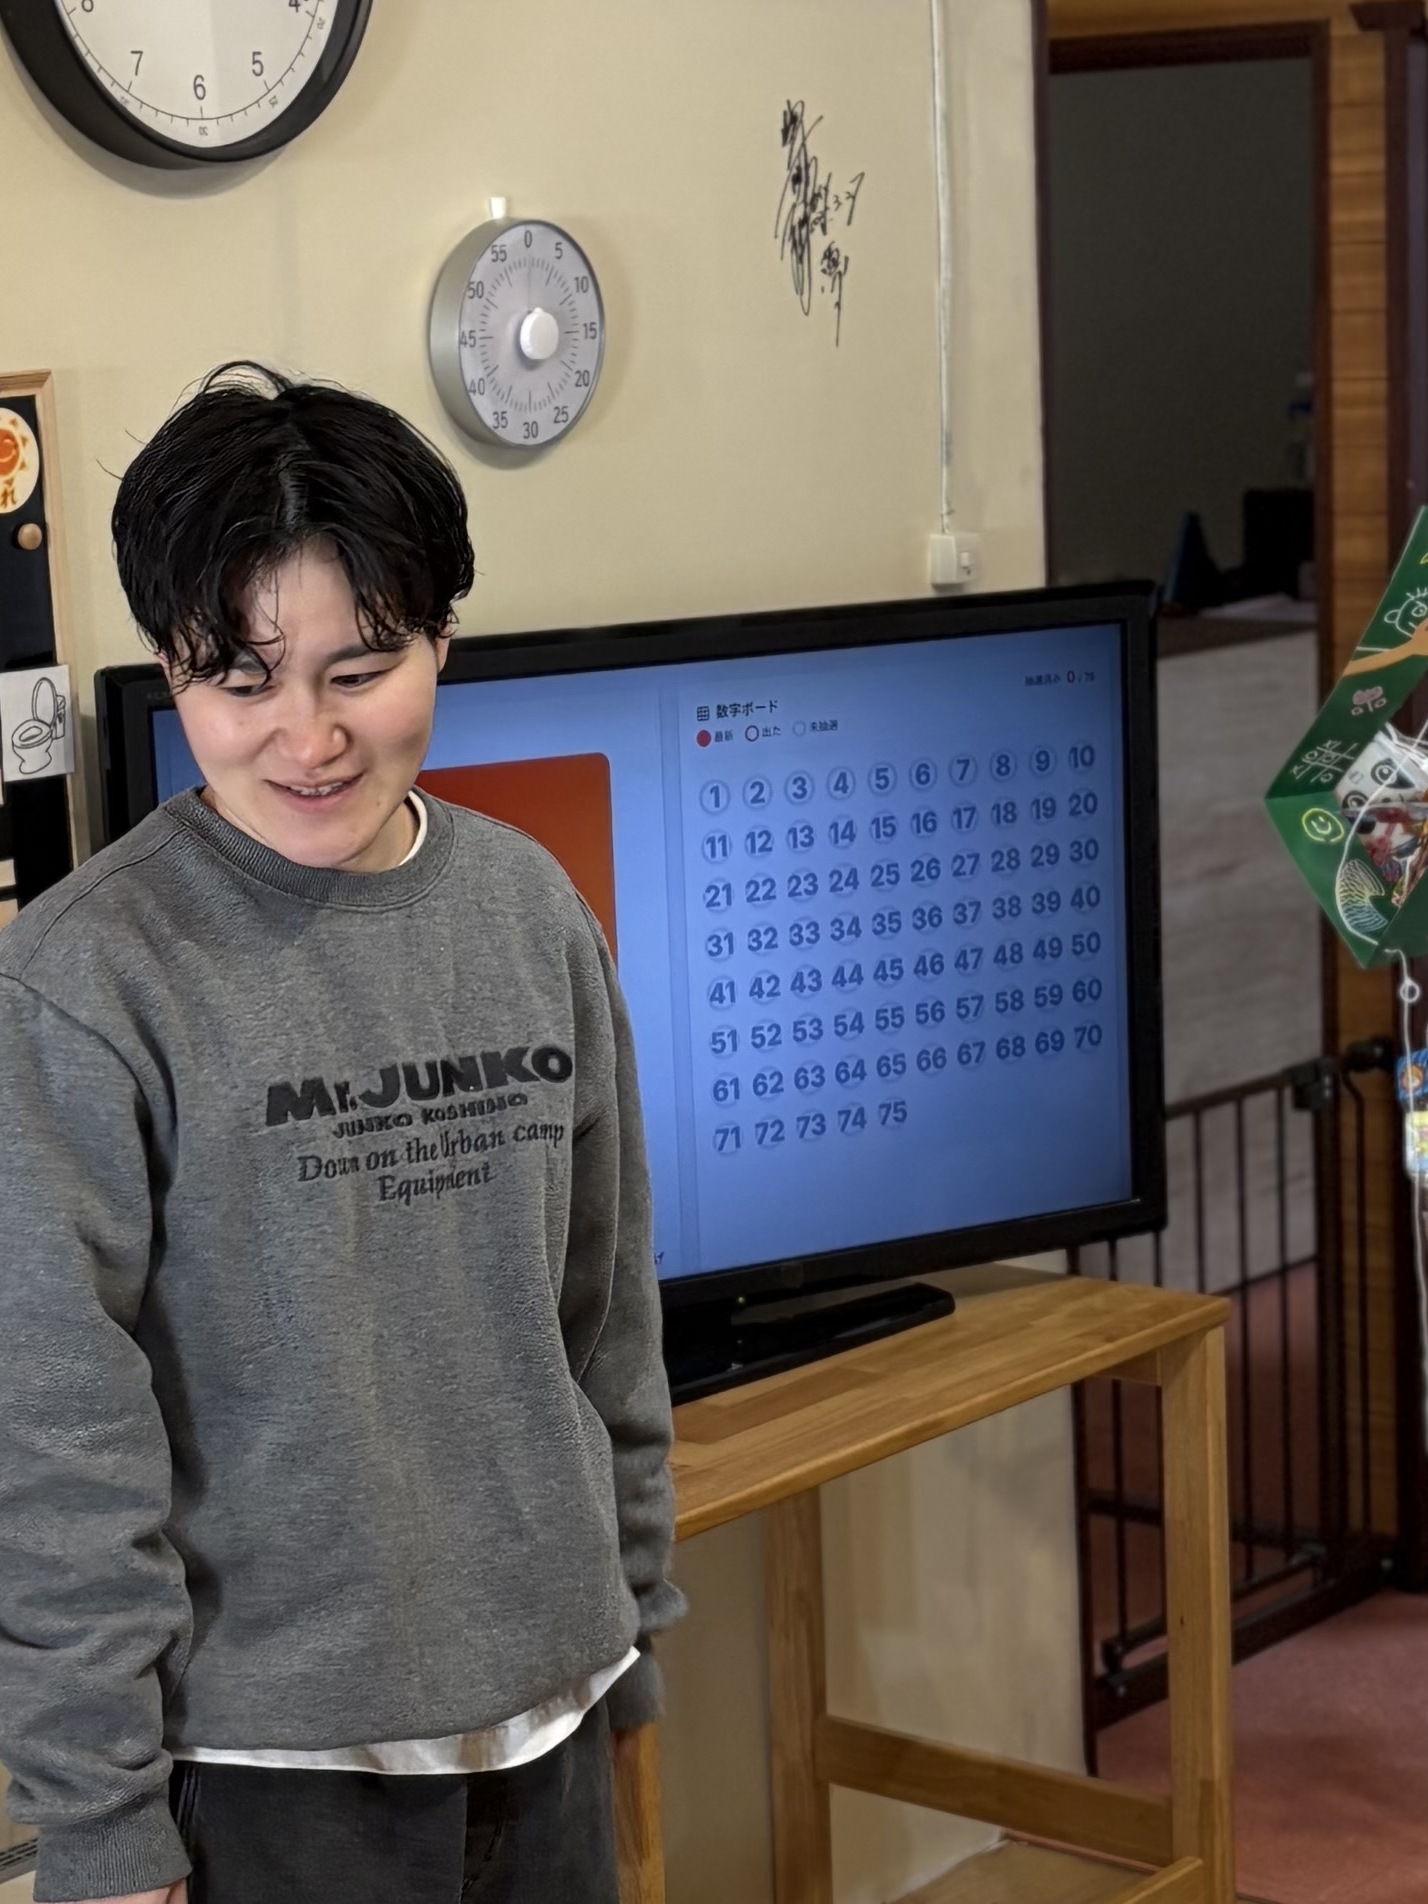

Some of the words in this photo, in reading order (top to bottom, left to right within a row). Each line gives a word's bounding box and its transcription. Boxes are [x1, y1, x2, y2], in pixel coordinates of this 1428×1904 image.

[130, 50, 144, 76] 7
[251, 51, 264, 77] 5
[193, 74, 207, 101] 6
[524, 230, 533, 248] 0
[491, 244, 508, 263] 55
[555, 242, 563, 260] 5
[467, 280, 485, 299] 50
[574, 275, 590, 294] 10
[460, 330, 477, 347] 45
[583, 322, 598, 340] 15
[468, 377, 486, 396] 40
[574, 369, 591, 387] 20
[492, 411, 509, 430] 35
[553, 406, 570, 424] 25
[523, 421, 539, 439] 30
[716, 700, 779, 720] 数字ボード
[709, 785, 721, 808] 1
[749, 780, 766, 804] 2
[792, 775, 808, 800] 3
[833, 771, 849, 794] 4
[875, 767, 890, 791] 5
[915, 762, 931, 786] 6
[956, 758, 971, 782] 7
[995, 753, 1011, 777] 8
[1035, 749, 1051, 773] 9
[1069, 744, 1096, 769] 10
[706, 834, 728, 859] 11
[745, 829, 773, 855] 12
[787, 824, 815, 849] 13
[829, 819, 857, 845] 14
[870, 814, 897, 840] 15
[911, 810, 938, 835] 16
[952, 805, 977, 830] 17
[991, 800, 1018, 826] 18
[1031, 796, 1057, 821] 19
[1068, 790, 1099, 817] 20
[705, 882, 732, 909] 21
[745, 877, 777, 903] 22
[787, 872, 819, 898] 23
[828, 867, 860, 893] 24
[870, 862, 901, 888] 25
[910, 856, 941, 883] 26
[952, 852, 981, 878] 27
[991, 847, 1021, 873] 28
[1030, 842, 1061, 868] 29
[1069, 837, 1100, 863] 30
[707, 931, 734, 958] 31
[747, 926, 779, 953] 32
[789, 920, 821, 947] 33
[830, 915, 863, 942] 34
[872, 910, 902, 936] 35
[912, 904, 943, 931] 36
[953, 900, 982, 926] 37
[992, 894, 1023, 920] 38
[1031, 889, 1062, 915] 39
[1070, 884, 1101, 910] 40
[709, 980, 736, 1005] 41
[748, 973, 781, 1000] 42
[790, 968, 823, 994] 43
[831, 963, 865, 988] 44
[872, 957, 905, 982] 45
[913, 952, 945, 977] 46
[954, 946, 984, 971] 47
[993, 941, 1024, 966] 48
[1032, 936, 1063, 961] 49
[1071, 930, 1102, 957] 50
[711, 1028, 738, 1055] 51
[751, 1022, 783, 1050] 52
[792, 1017, 824, 1043] 53
[833, 1011, 865, 1038] 54
[875, 1005, 905, 1032] 55
[915, 999, 946, 1026] 56
[956, 994, 985, 1021] 57
[995, 988, 1025, 1014] 58
[1034, 983, 1064, 1009] 59
[1072, 977, 1103, 1004] 60
[712, 1077, 741, 1103] 61
[752, 1070, 785, 1097] 62
[794, 1064, 826, 1091] 63
[834, 1058, 868, 1085] 64
[876, 1052, 907, 1079] 65
[916, 1046, 948, 1073] 66
[957, 1040, 986, 1066] 67
[995, 1034, 1027, 1061] 68
[1034, 1029, 1065, 1055] 69
[1073, 1023, 1103, 1049] 70
[715, 1125, 741, 1152] 71
[754, 1118, 786, 1146] 72
[796, 1112, 827, 1139] 73
[837, 1106, 867, 1133] 74
[878, 1100, 908, 1126] 75
[365, 1149, 399, 1171] on
[406, 1137, 439, 1164] the
[512, 1120, 565, 1149] camp
[376, 1160, 498, 1206] Equipment
